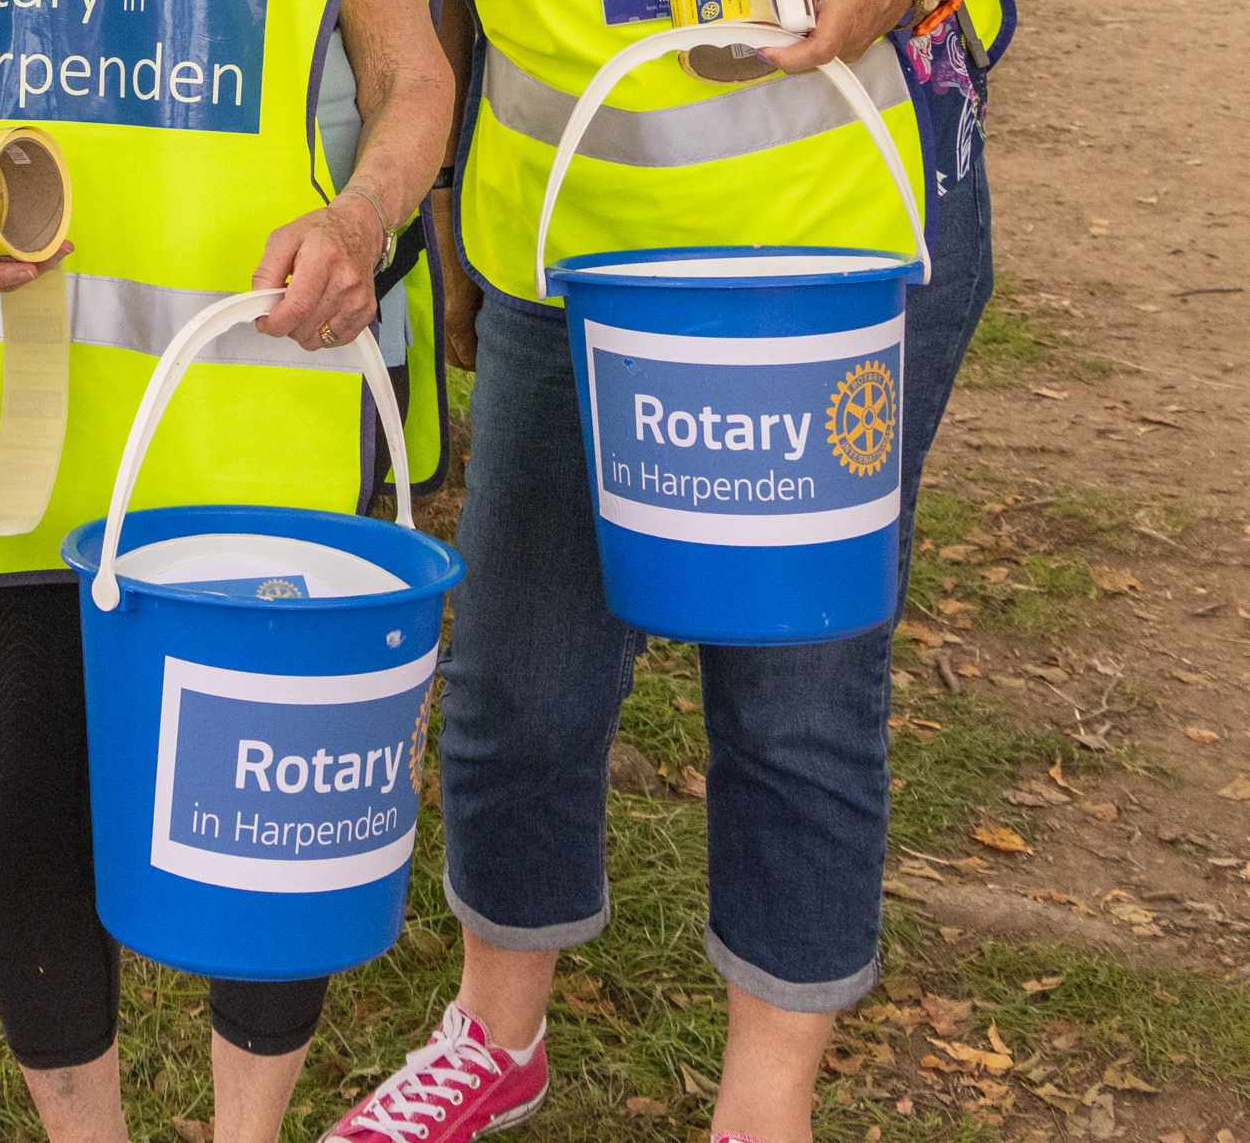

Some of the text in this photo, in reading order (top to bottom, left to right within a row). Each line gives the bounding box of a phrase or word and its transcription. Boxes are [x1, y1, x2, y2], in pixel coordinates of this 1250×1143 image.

[851, 372, 882, 390] ROTARY
[634, 393, 811, 461] Rotary
[612, 452, 815, 506] in Harpenden
[235, 739, 404, 795] Rotary
[192, 801, 397, 854] in Harpenden
